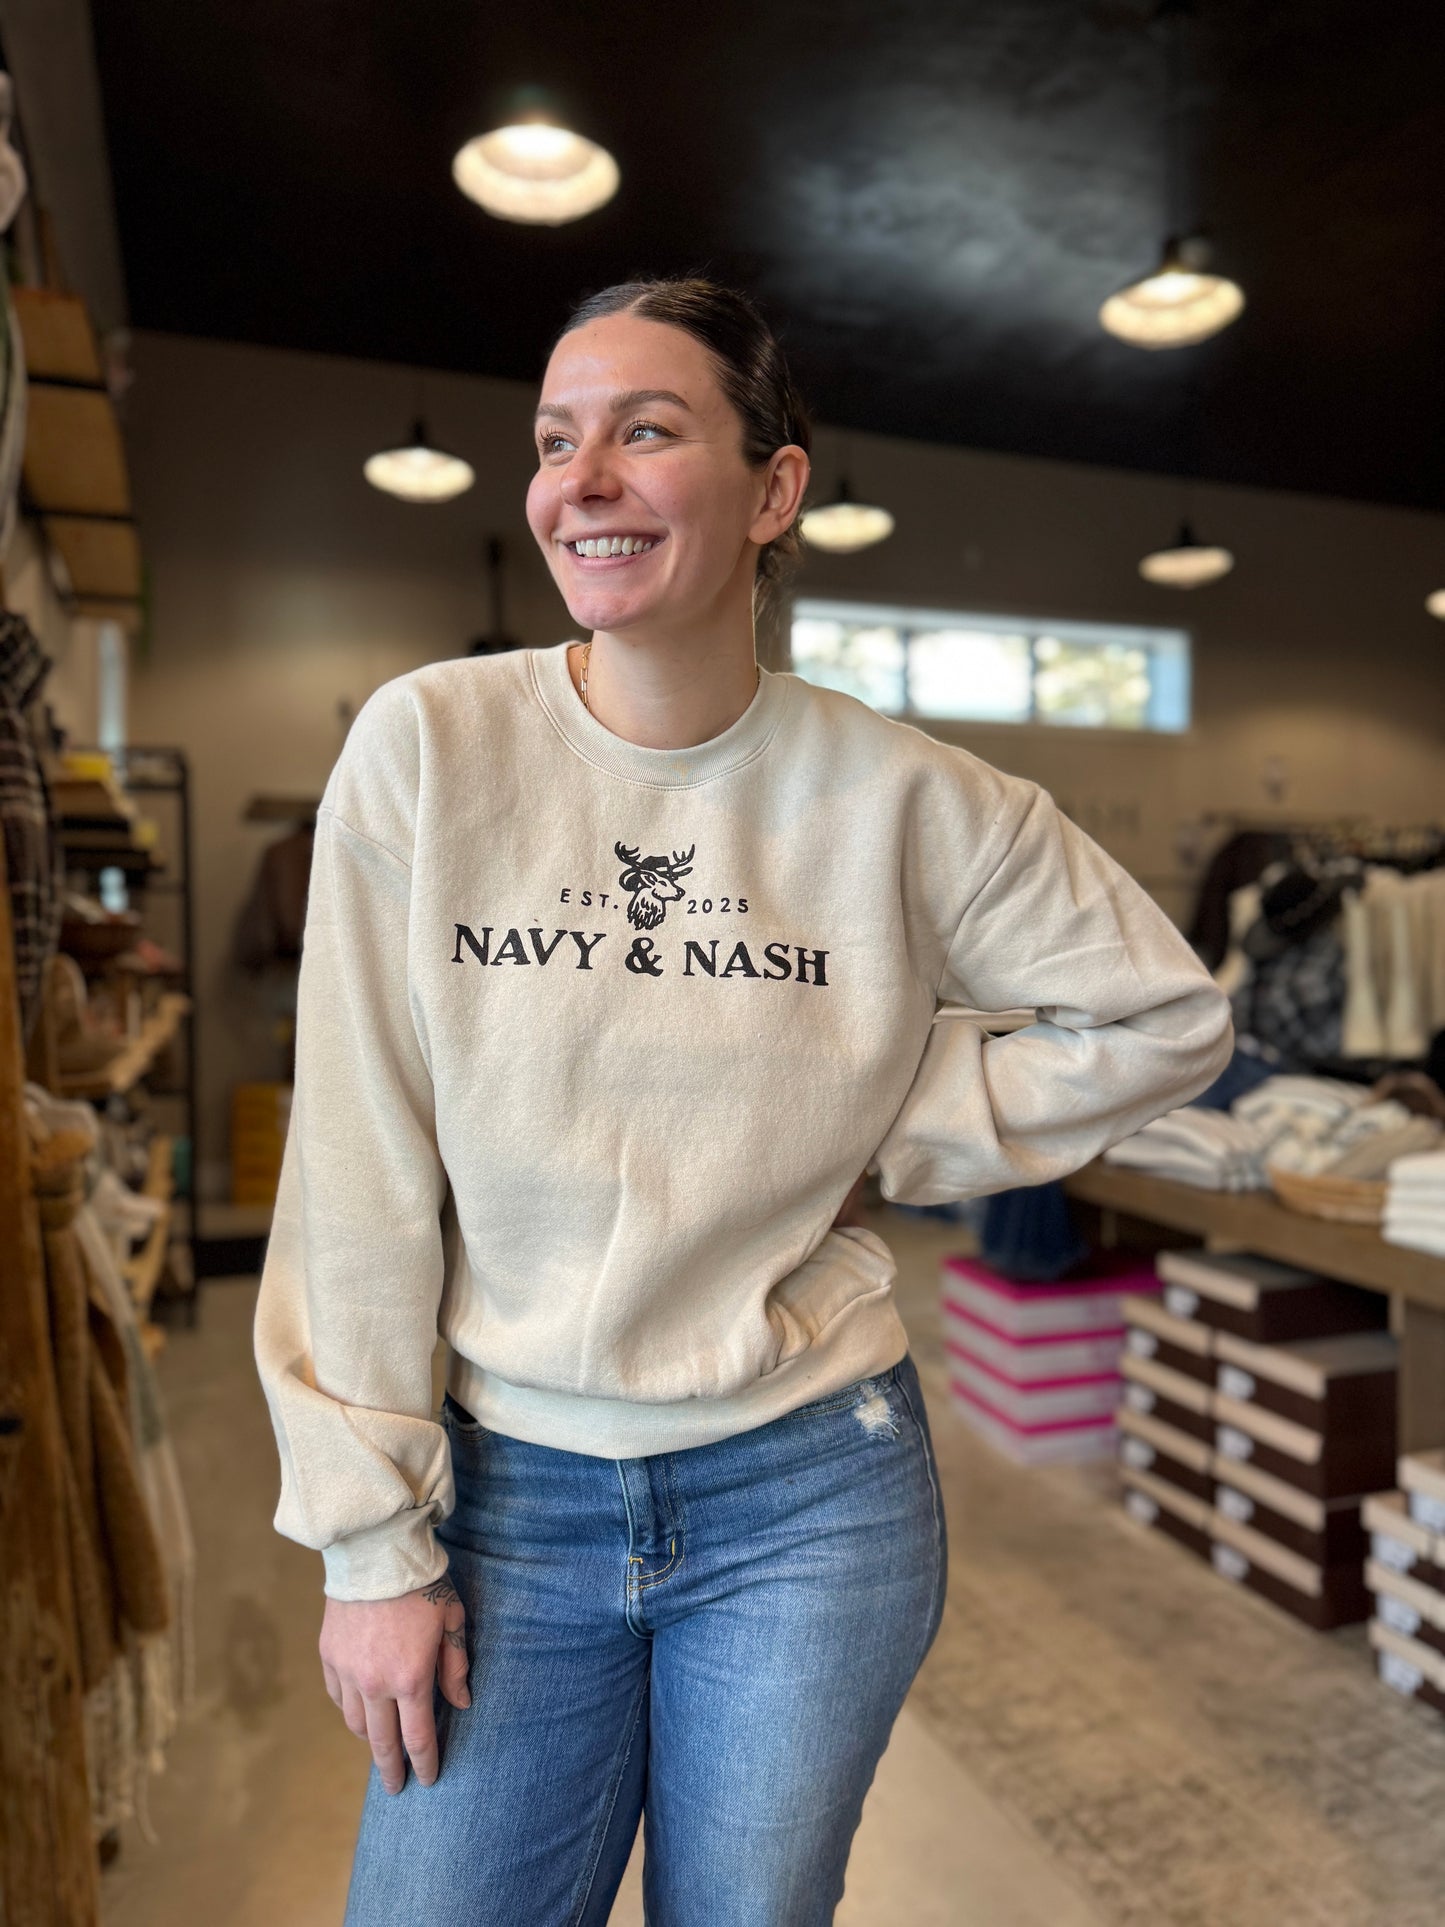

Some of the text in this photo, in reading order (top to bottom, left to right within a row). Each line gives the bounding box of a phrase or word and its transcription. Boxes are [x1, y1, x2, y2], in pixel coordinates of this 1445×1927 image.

[560, 887, 749, 915] EST. 2025
[450, 923, 830, 986] NAVY & NASH
